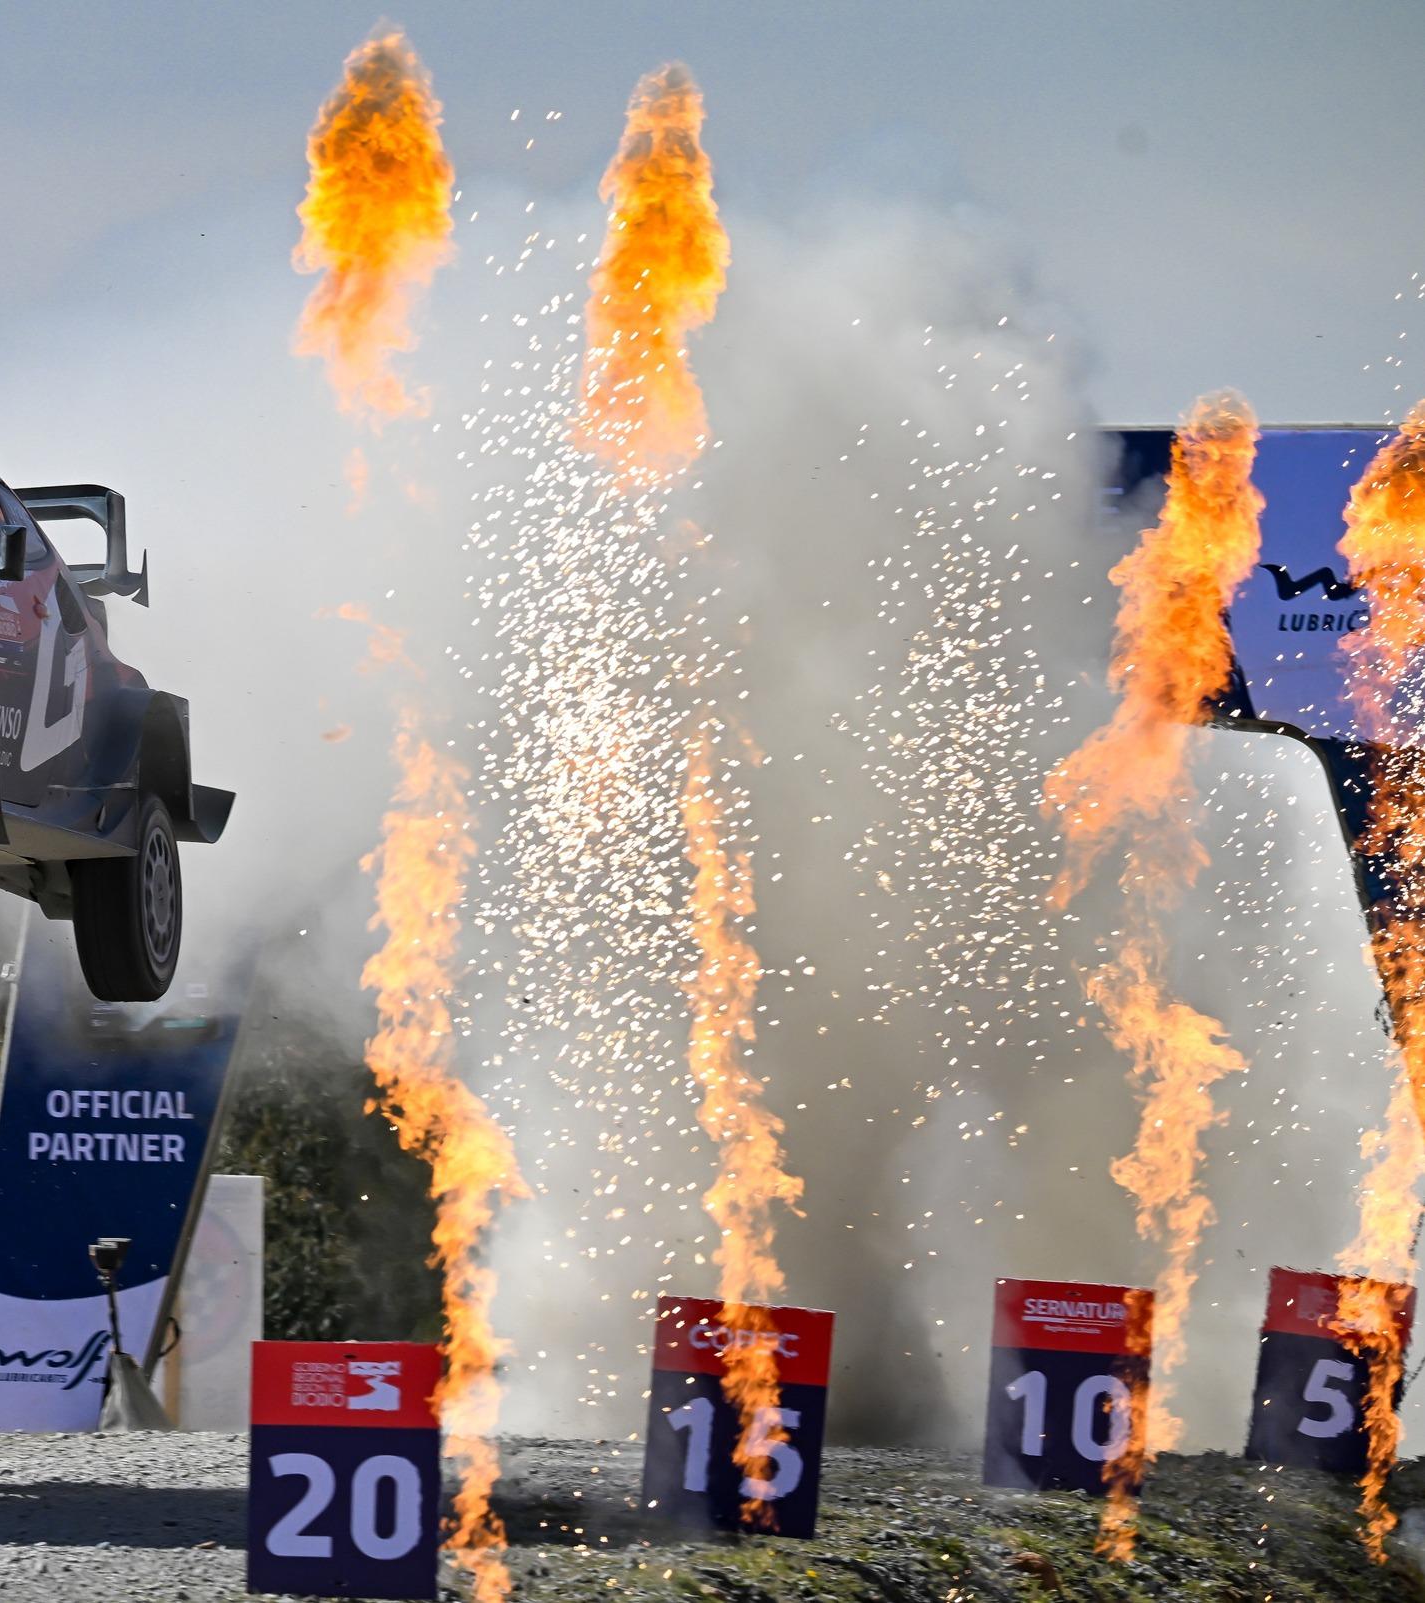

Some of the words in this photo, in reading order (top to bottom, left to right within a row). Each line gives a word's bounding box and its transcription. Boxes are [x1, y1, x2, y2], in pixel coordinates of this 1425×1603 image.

[47, 1089, 194, 1119] OFFICIAL
[28, 1132, 185, 1163] PARTNER
[1023, 1298, 1126, 1321] SERNATUR
[1005, 1370, 1131, 1461] 10
[1297, 1358, 1356, 1438] 5
[666, 1397, 804, 1500] 15
[265, 1452, 422, 1560] 20
